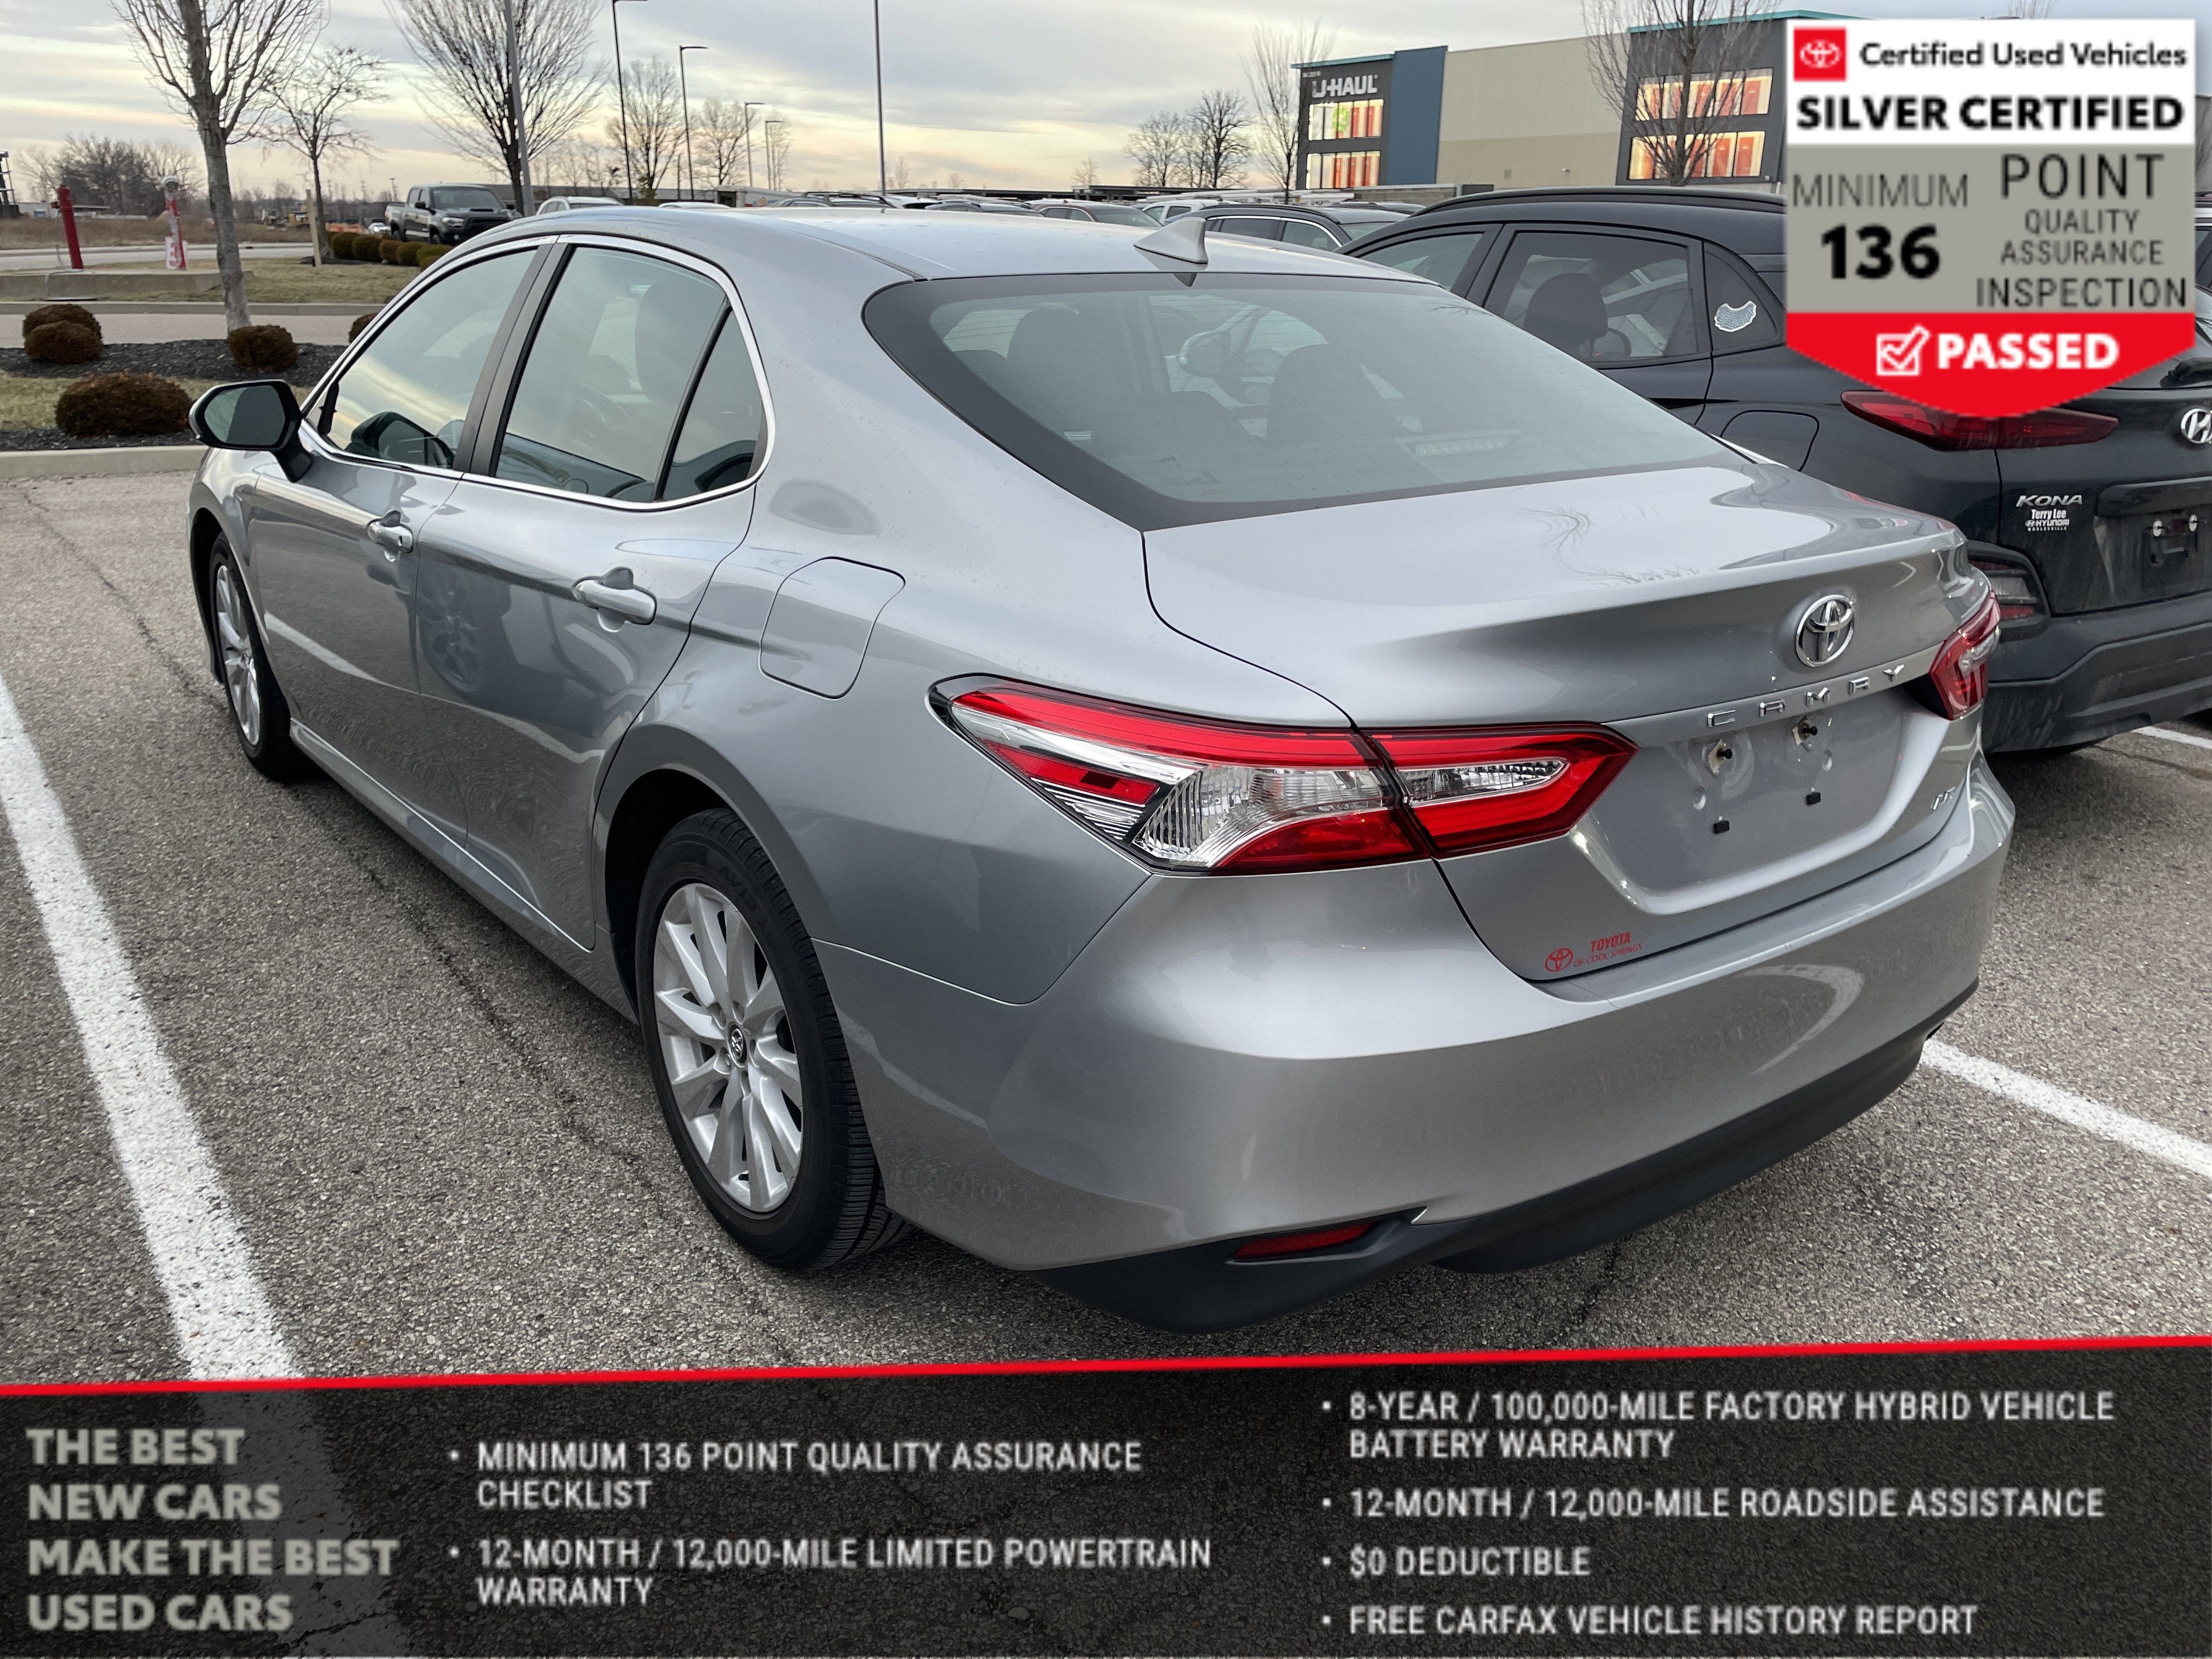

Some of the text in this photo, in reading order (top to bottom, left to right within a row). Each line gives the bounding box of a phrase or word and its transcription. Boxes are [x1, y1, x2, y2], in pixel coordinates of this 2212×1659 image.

[1311, 75, 1378, 98] U-HAUL
[2016, 494, 2083, 507] KONA
[2031, 509, 2052, 520] Terry
[2036, 518, 2070, 527] HYUNDAI
[1706, 663, 1905, 729] CAMRY
[1590, 932, 1632, 953] TOYOTA
[1573, 942, 1643, 968] OF COOL SPRINGS
